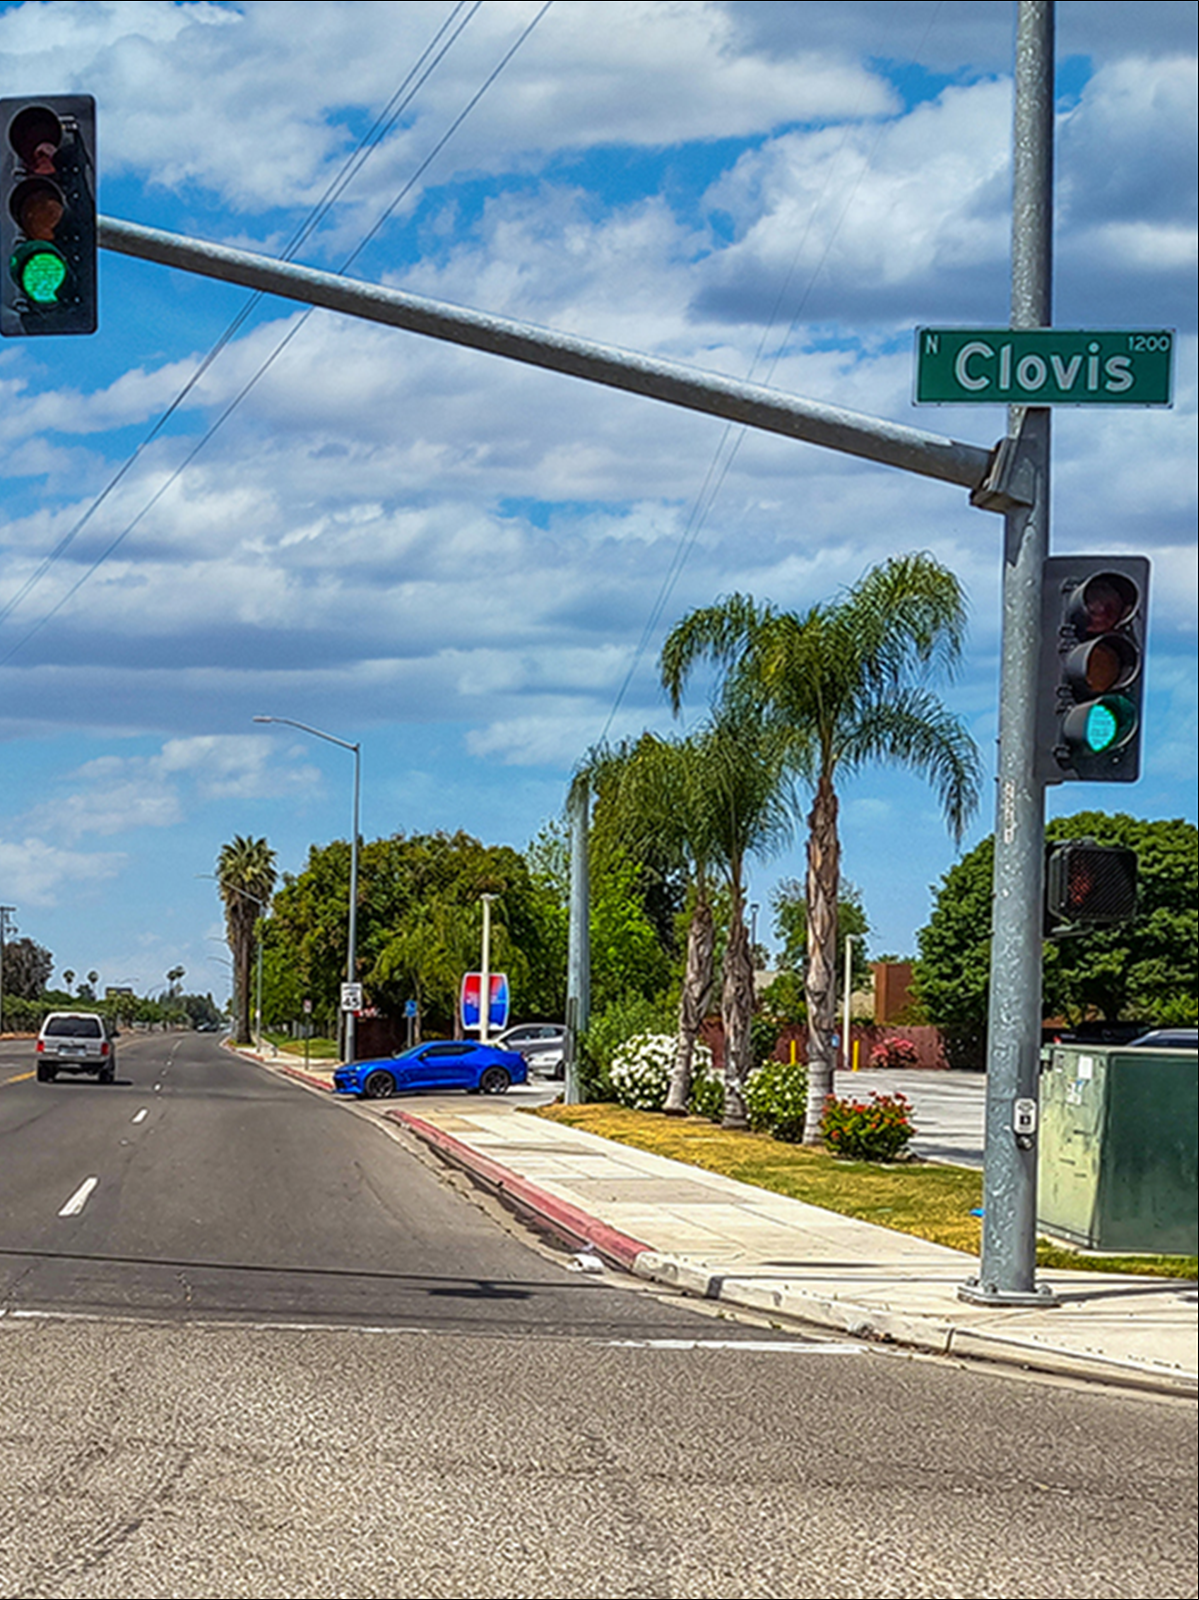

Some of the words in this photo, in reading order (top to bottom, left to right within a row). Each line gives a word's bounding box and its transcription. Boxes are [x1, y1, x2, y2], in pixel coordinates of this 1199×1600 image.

[925, 334, 939, 355] N
[1128, 335, 1171, 352] 1200
[954, 341, 1134, 392] Clovis
